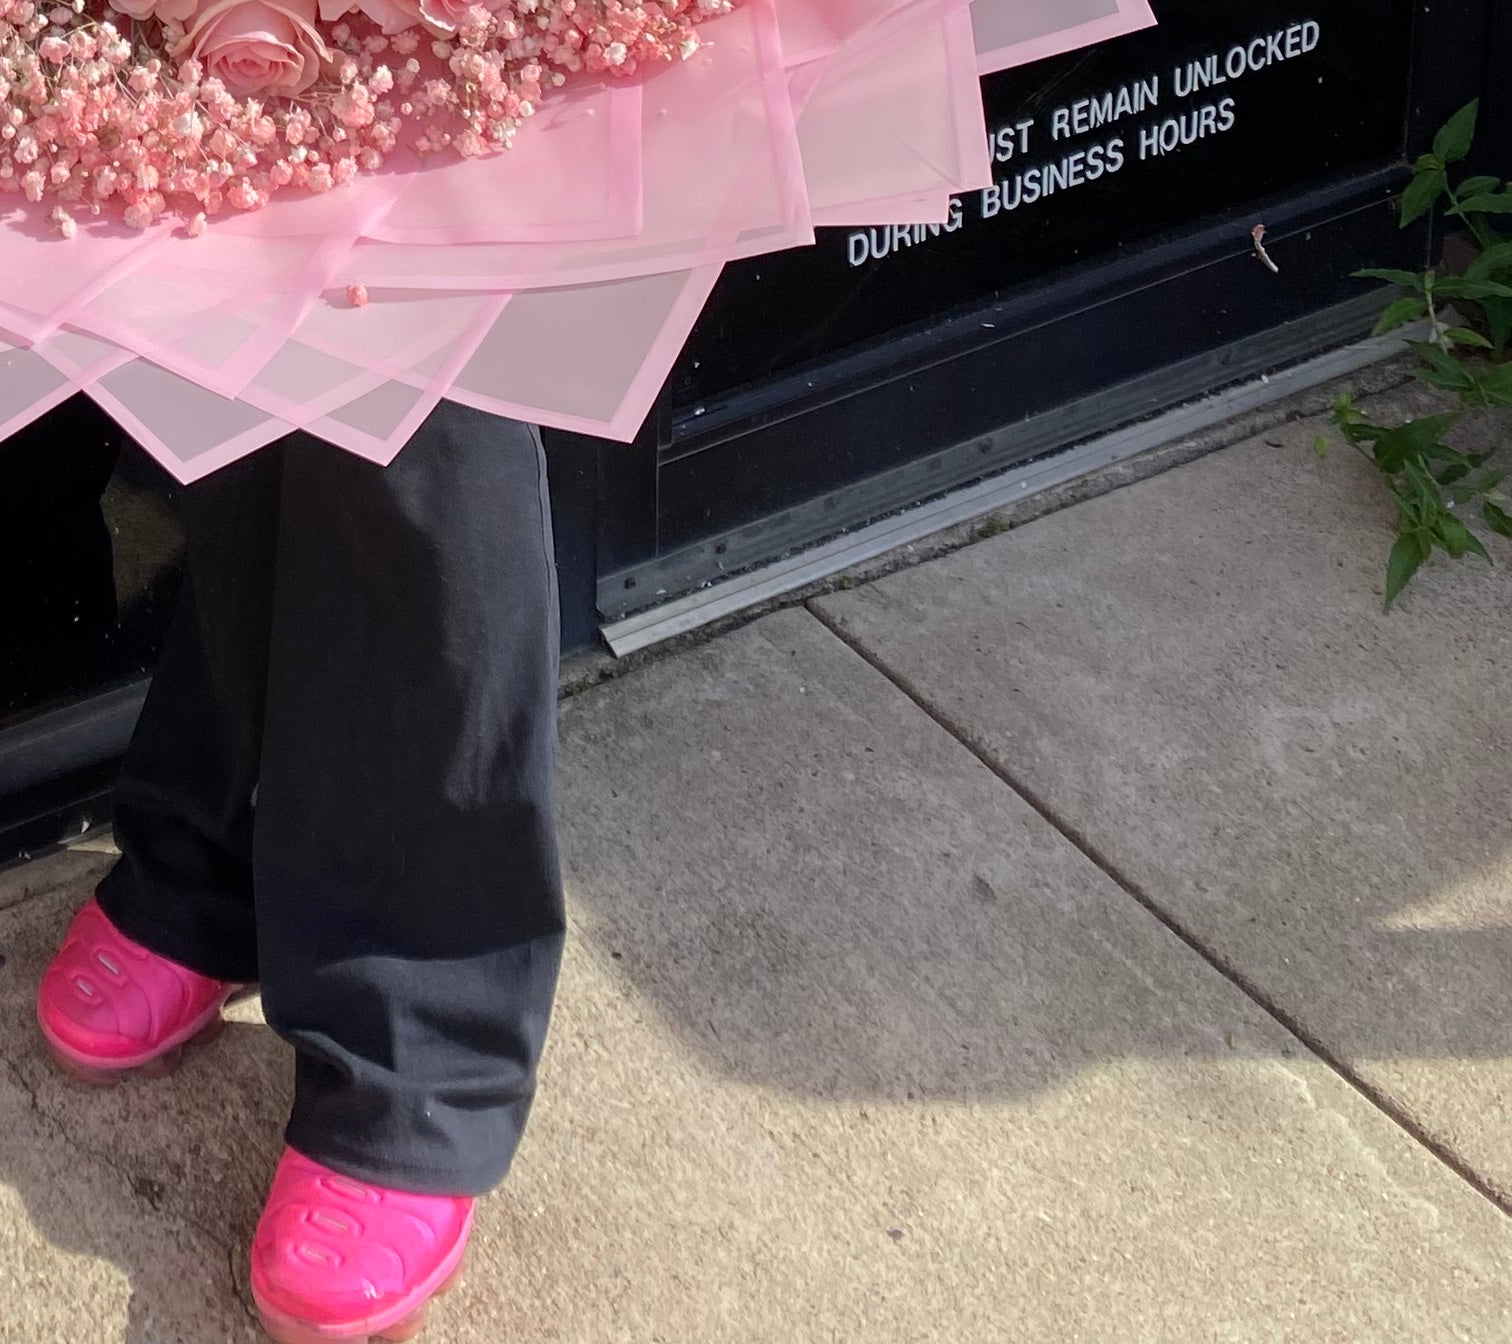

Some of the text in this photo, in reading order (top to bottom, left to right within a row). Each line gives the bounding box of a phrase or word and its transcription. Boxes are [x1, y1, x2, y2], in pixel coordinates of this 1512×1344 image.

[1051, 75, 1159, 141] REMAIN
[1173, 20, 1320, 98] UNLOCKED
[980, 138, 1125, 219] BUSINESS
[1139, 97, 1236, 161] HOURS
